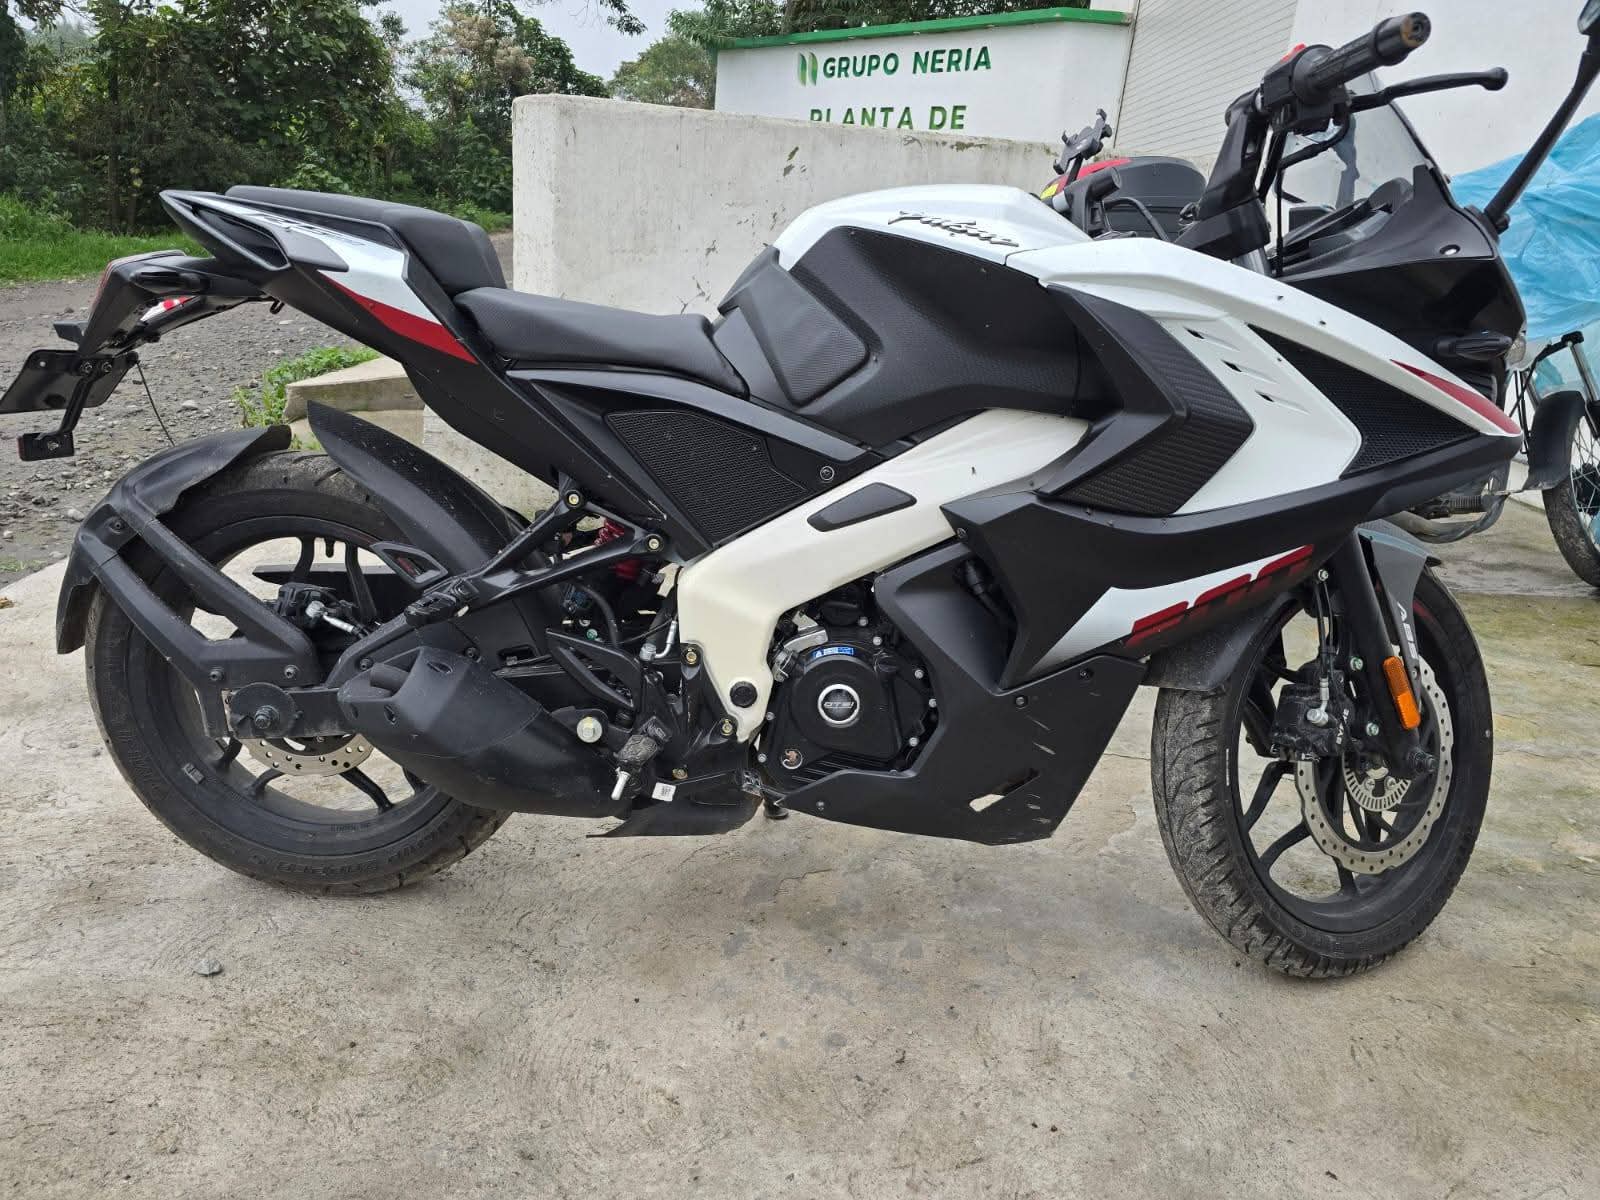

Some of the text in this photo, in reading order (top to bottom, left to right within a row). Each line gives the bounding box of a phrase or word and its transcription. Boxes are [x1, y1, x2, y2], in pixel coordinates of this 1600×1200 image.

[823, 46, 991, 78] GRUPO NERIA
[928, 105, 967, 130] DE
